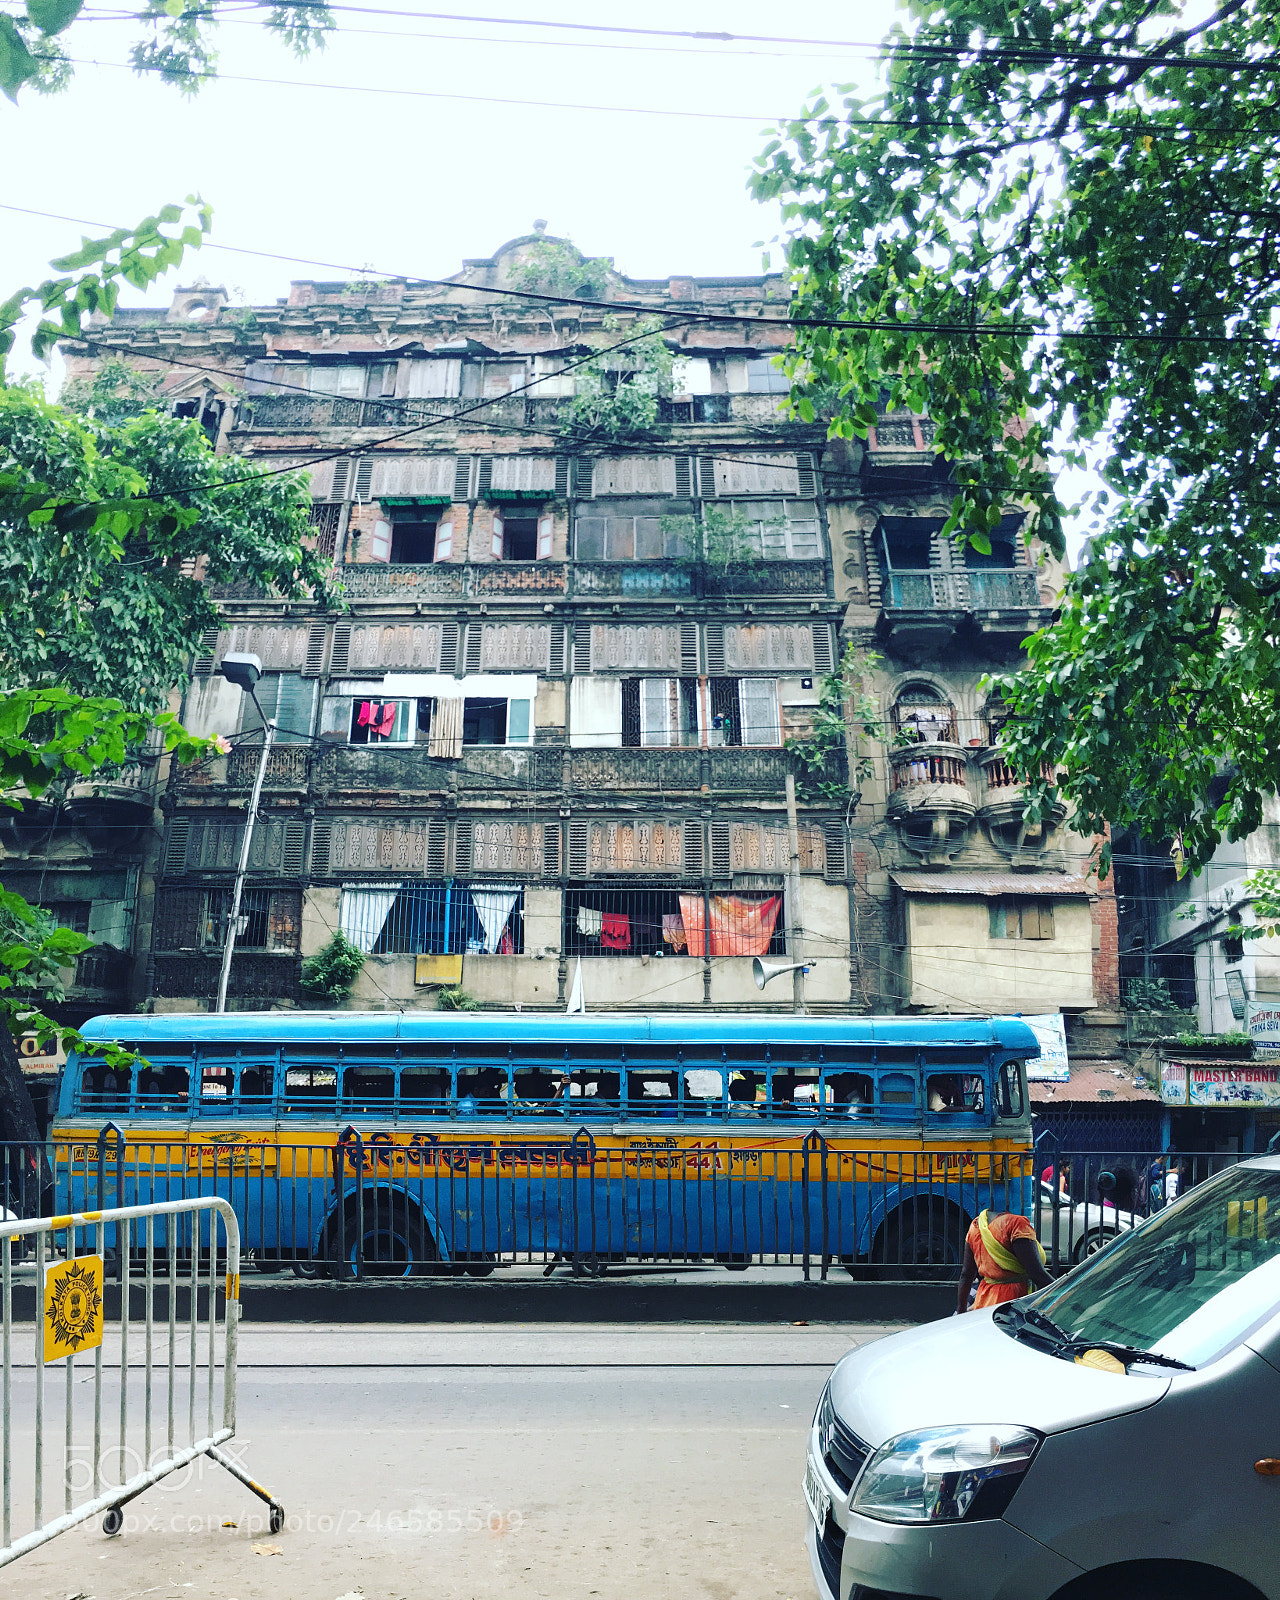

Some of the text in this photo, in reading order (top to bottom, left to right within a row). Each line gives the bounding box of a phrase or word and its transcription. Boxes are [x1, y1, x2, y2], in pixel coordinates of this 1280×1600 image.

[1194, 1068, 1278, 1082] MASTER BAND
[686, 1157, 724, 1171] 44A
